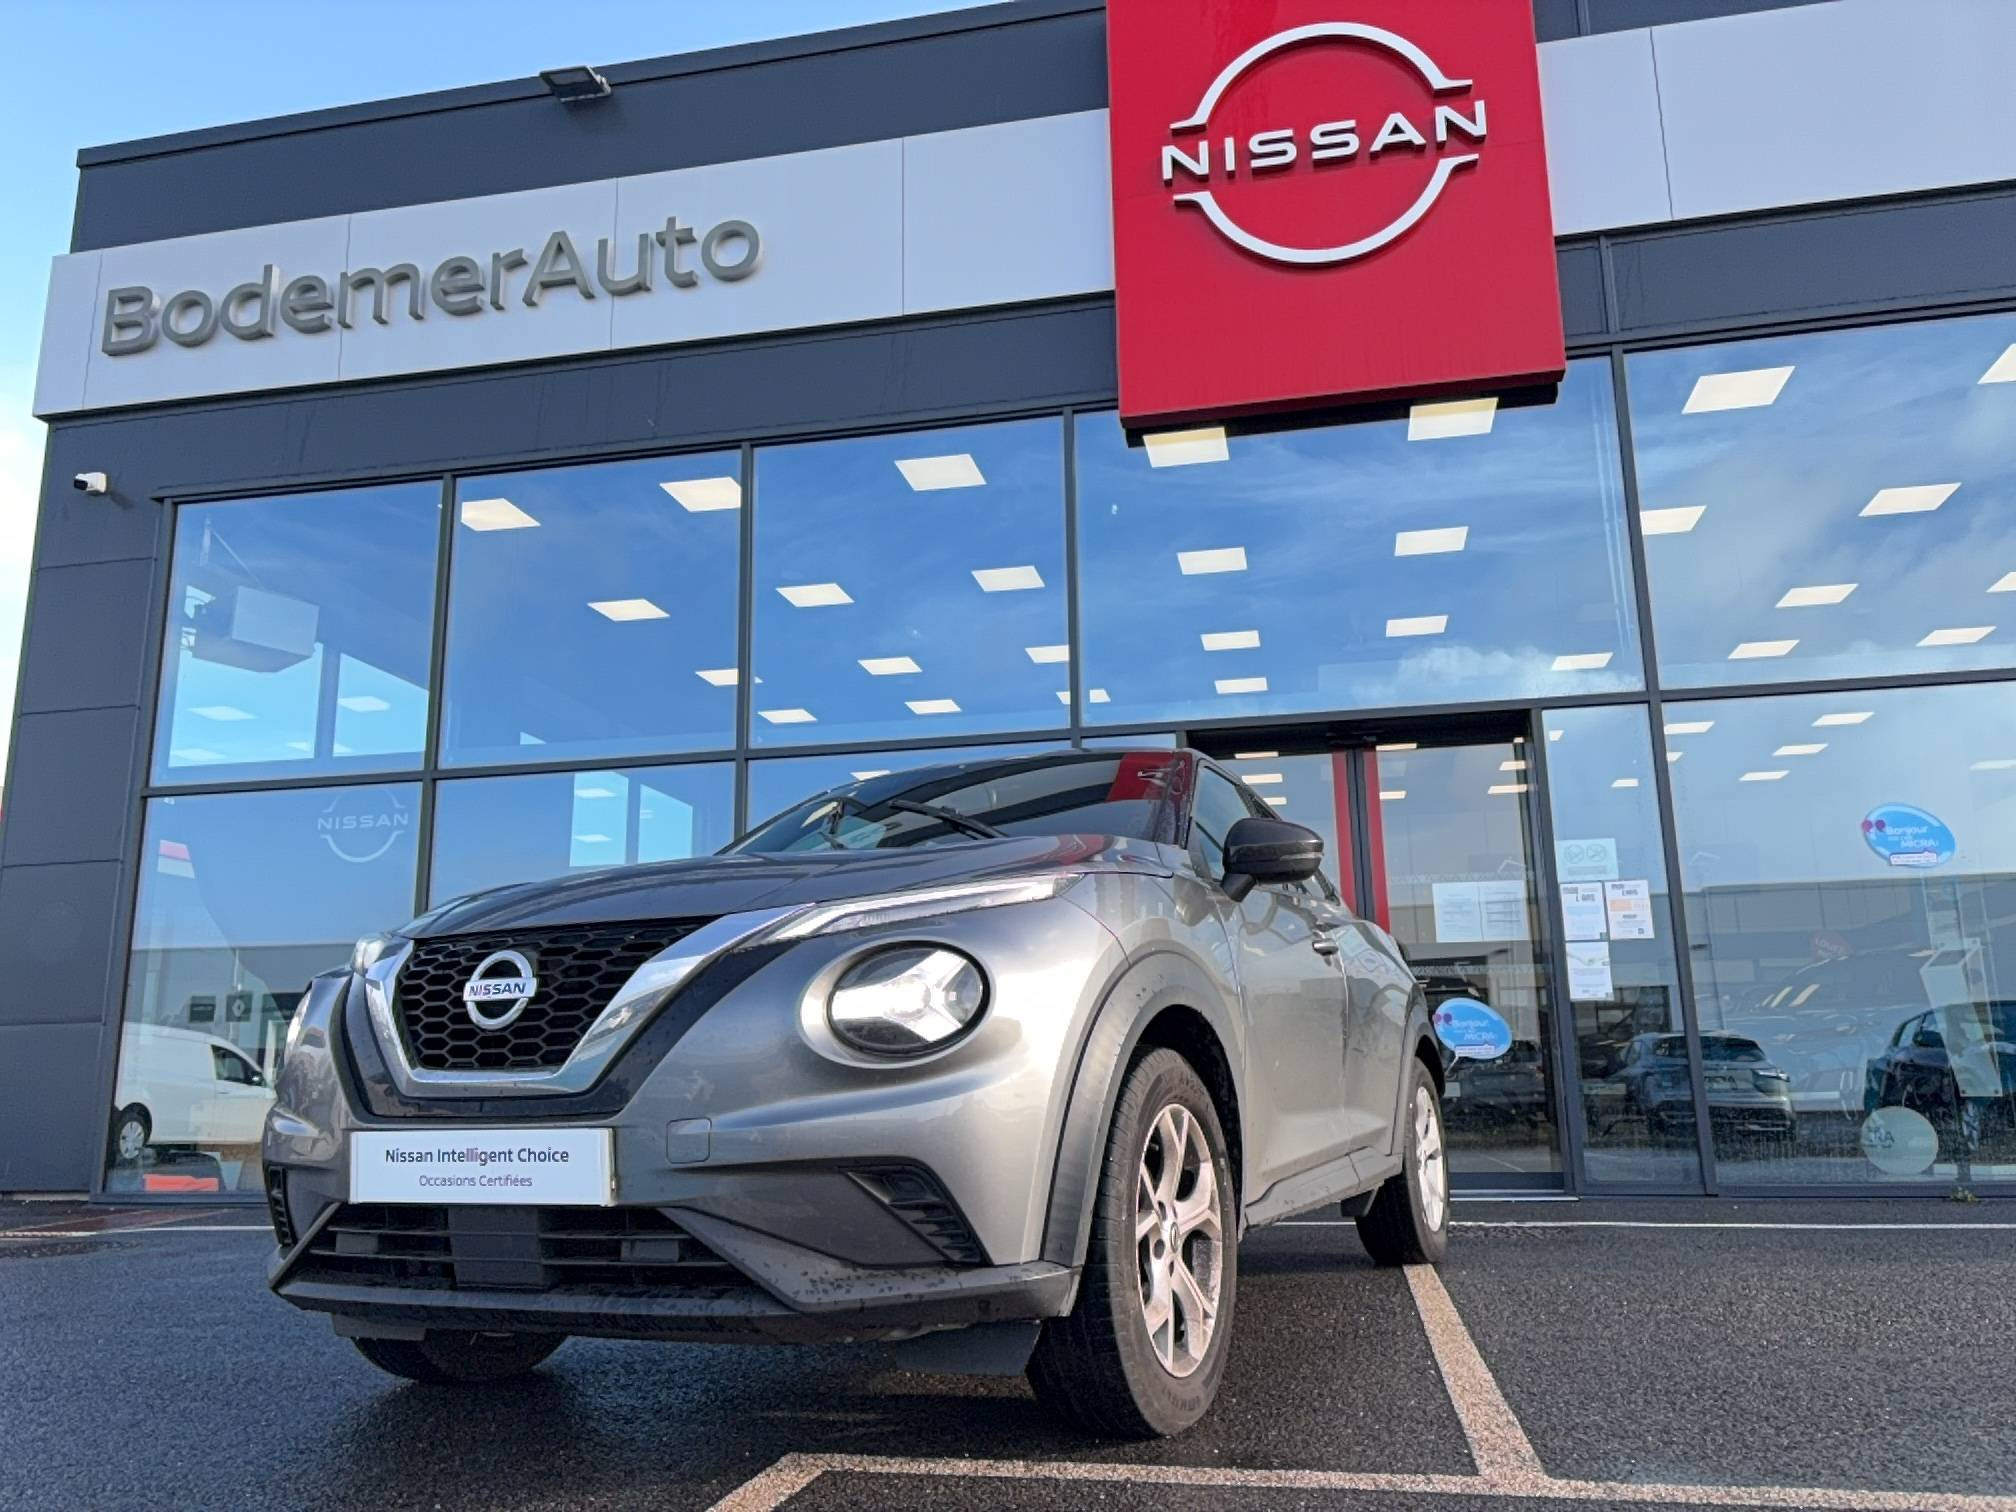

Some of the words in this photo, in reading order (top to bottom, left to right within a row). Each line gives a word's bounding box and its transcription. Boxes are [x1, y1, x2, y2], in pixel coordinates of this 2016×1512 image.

[1161, 99, 1487, 184] NISSAN
[101, 215, 763, 356] BodemerAuto
[317, 812, 409, 831] NISSAN
[468, 981, 527, 997] NISSAN
[385, 1148, 433, 1163] Nissan
[437, 1147, 514, 1167] Intelligent
[517, 1146, 569, 1163] Choice
[418, 1174, 477, 1187] Occasions
[479, 1173, 533, 1187] Certifiées
